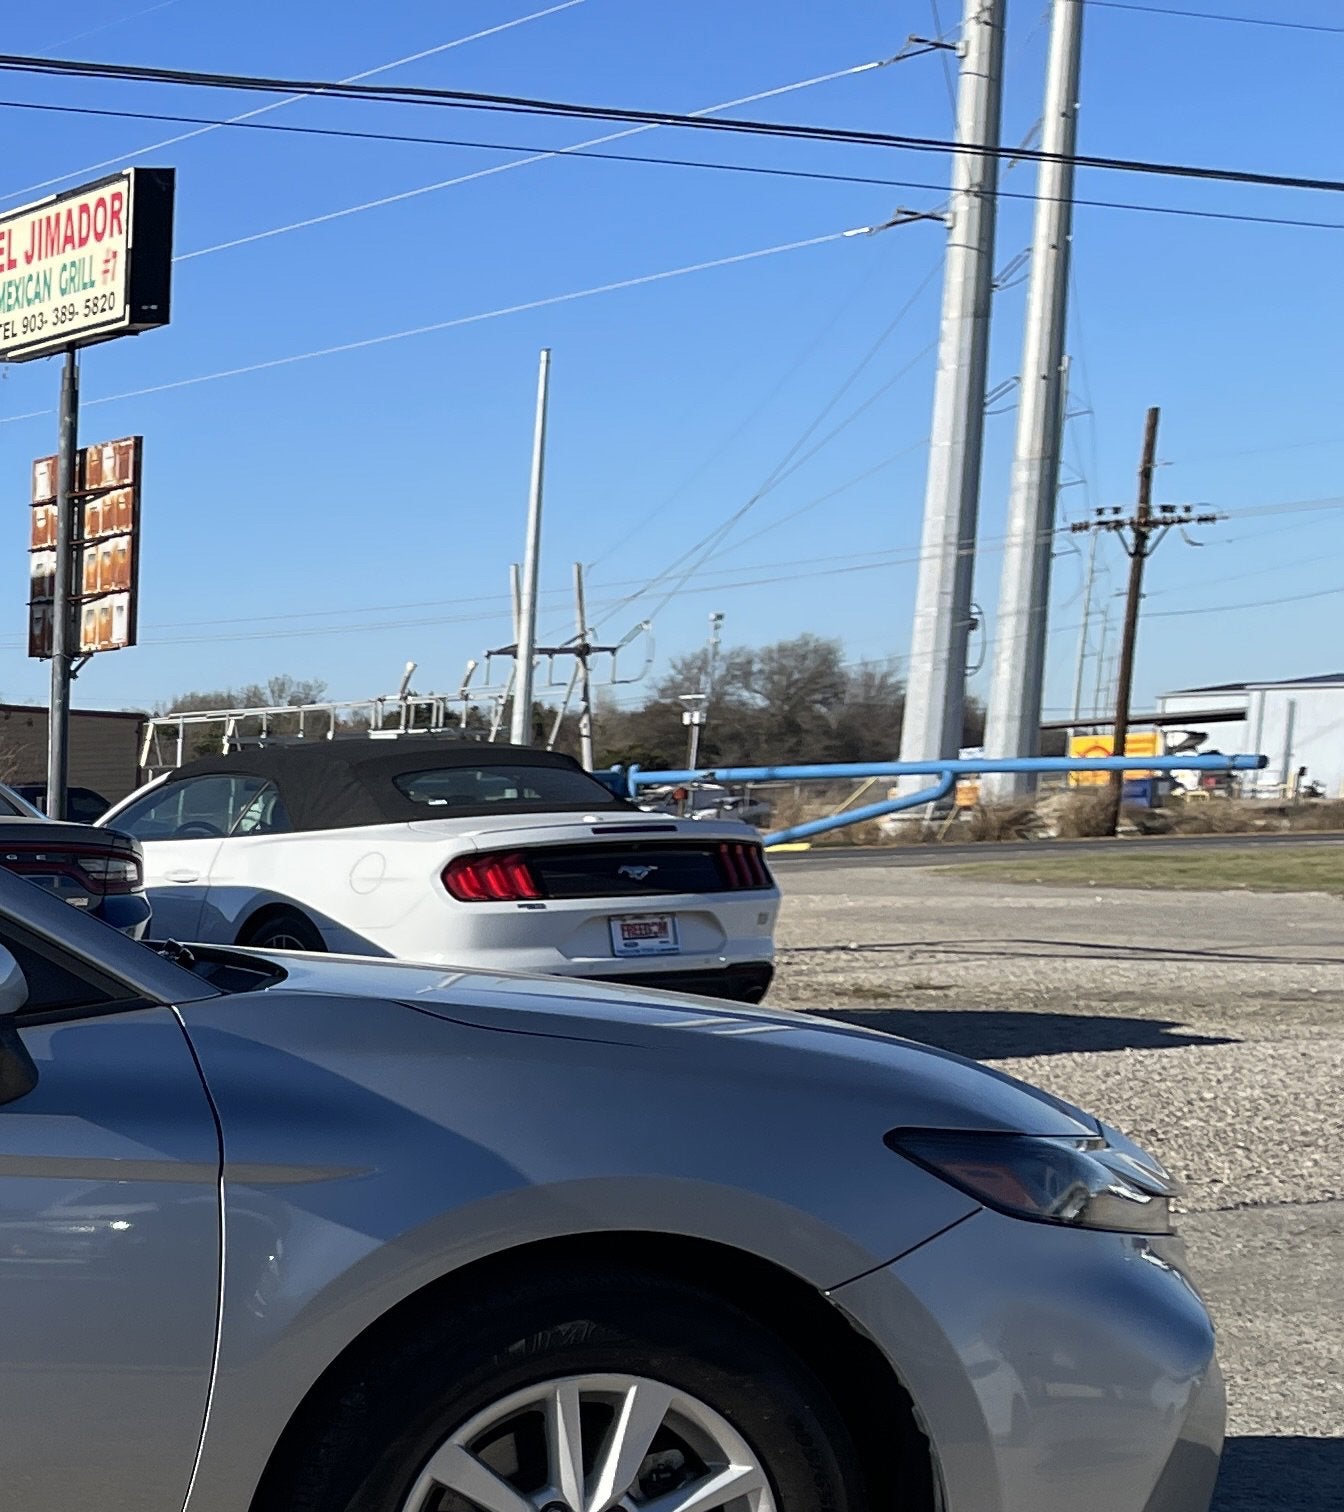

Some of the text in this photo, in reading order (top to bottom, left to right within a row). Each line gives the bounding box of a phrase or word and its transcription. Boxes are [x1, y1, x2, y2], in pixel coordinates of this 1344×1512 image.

[24, 191, 123, 265] JIMADOR
[59, 255, 96, 297] GRILL
[101, 247, 118, 286] #7
[83, 291, 116, 318] 5820
